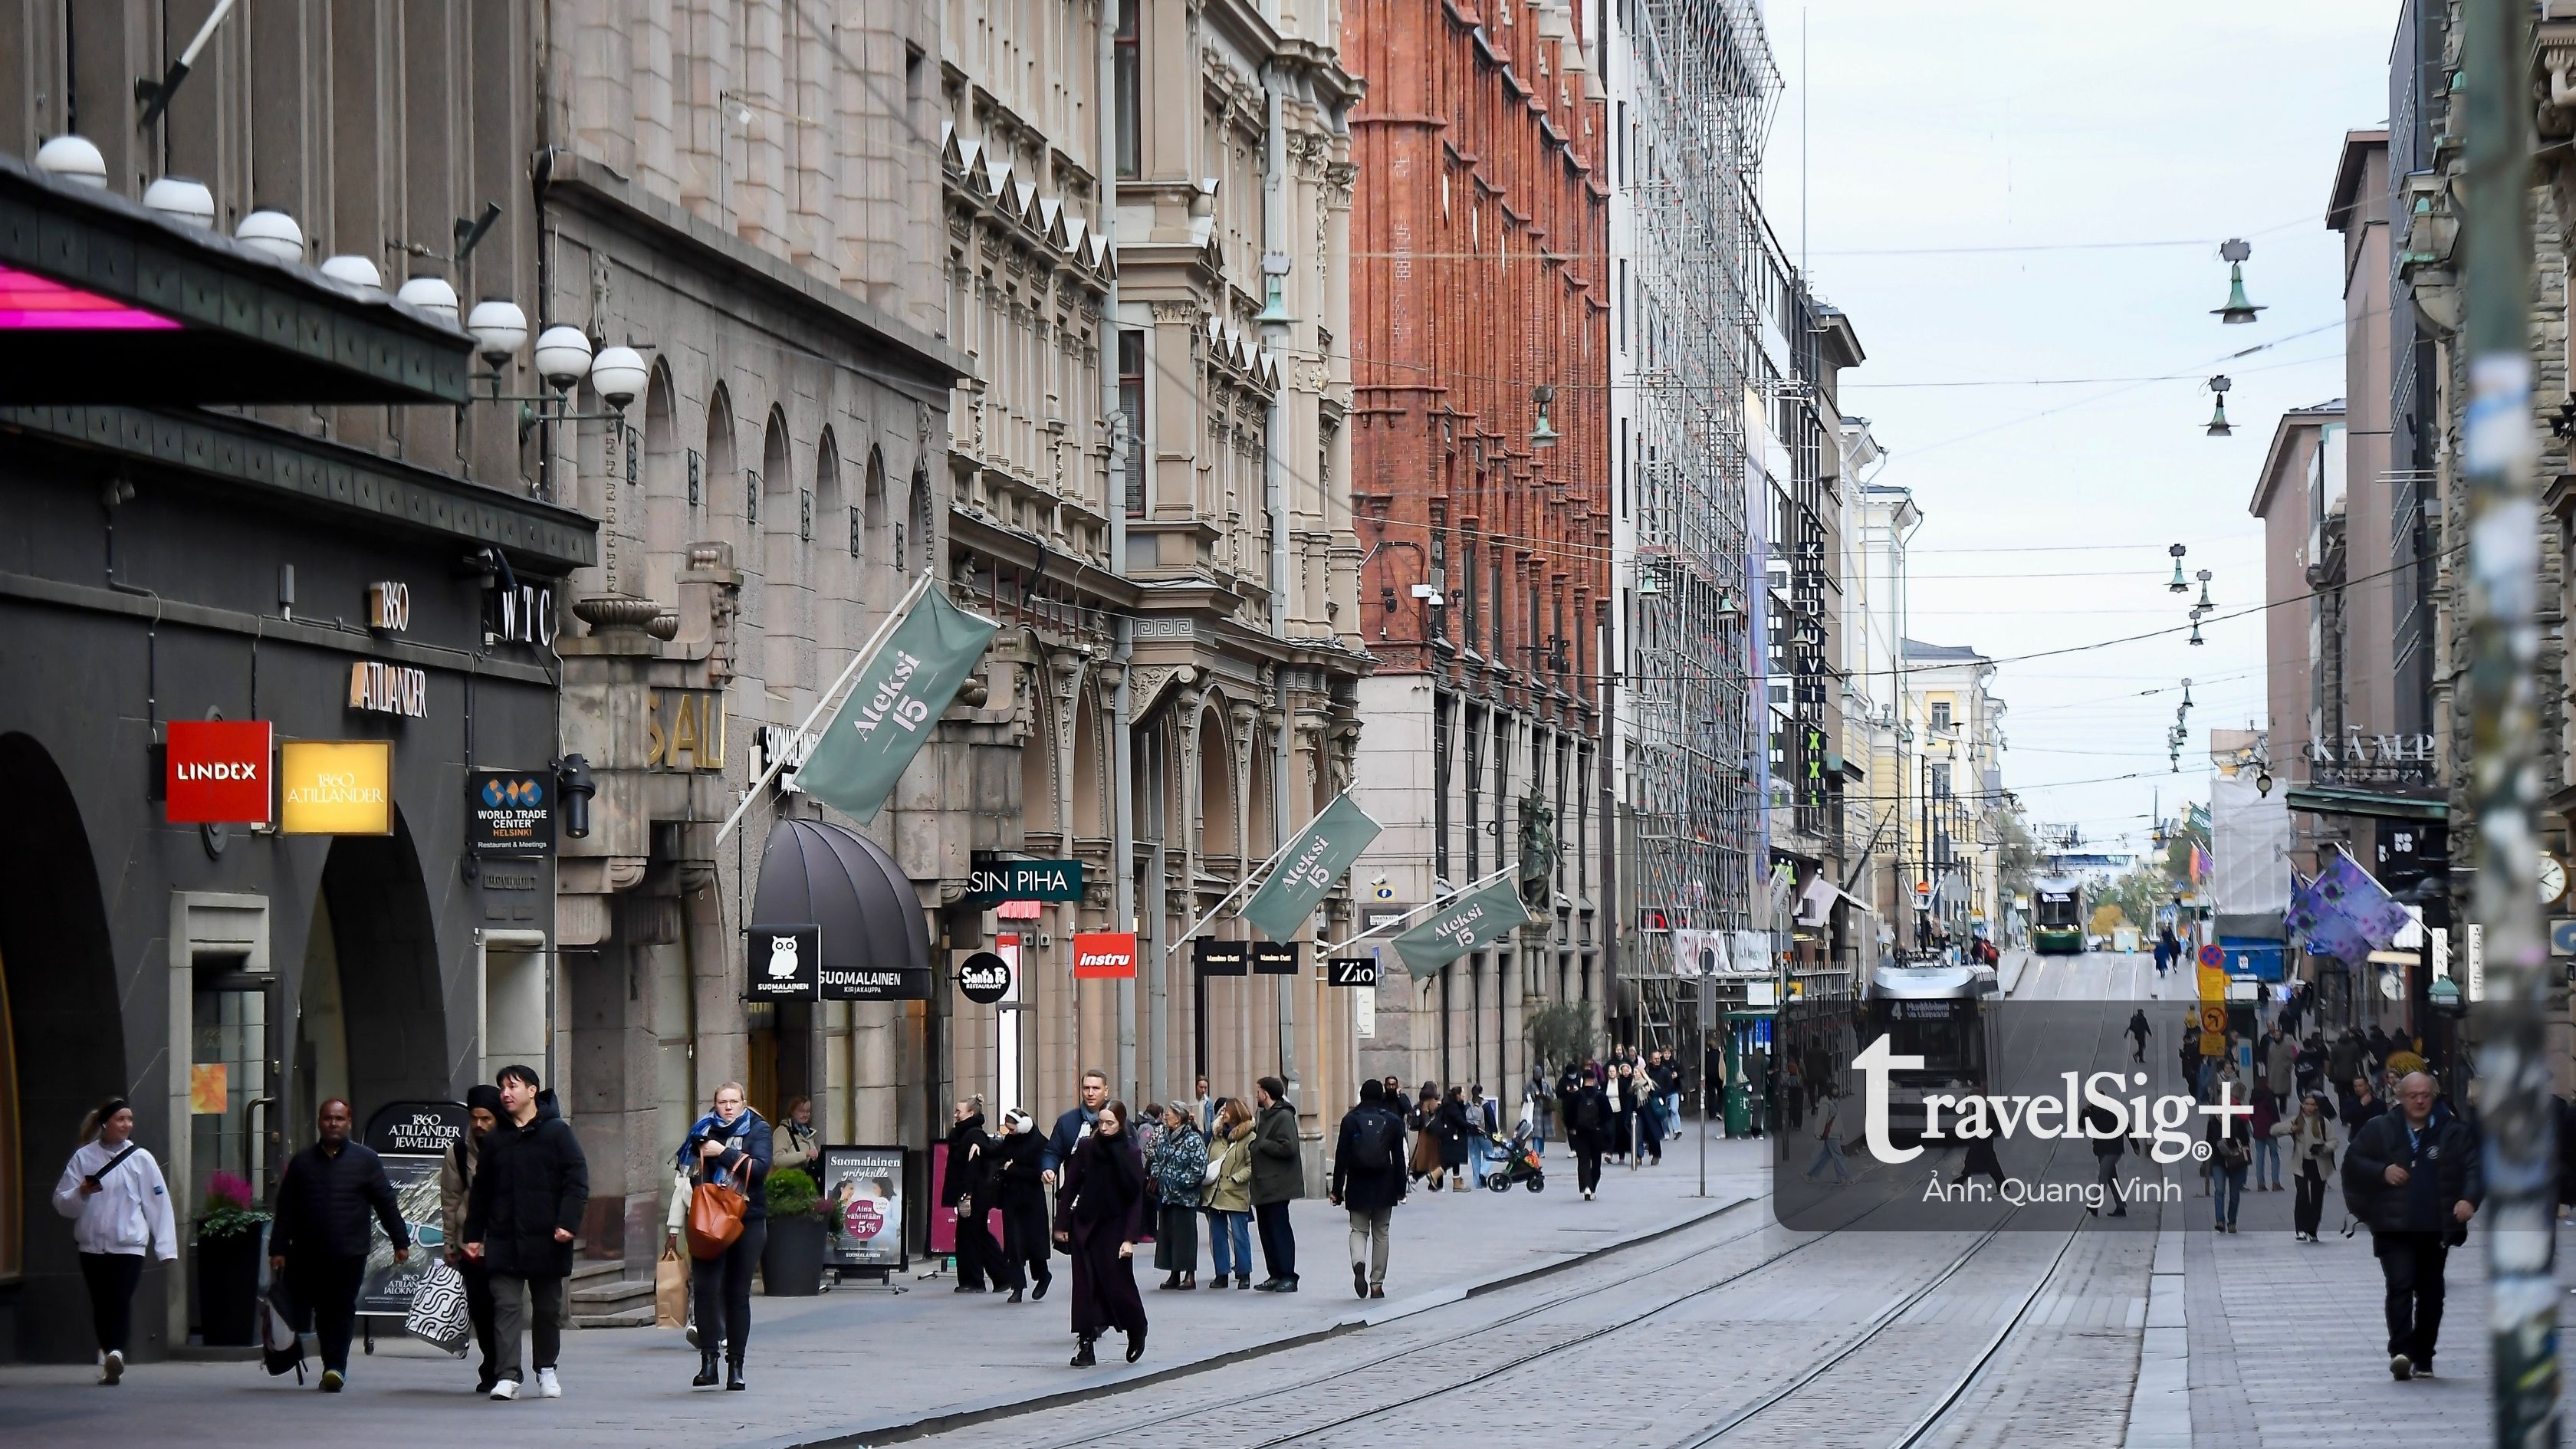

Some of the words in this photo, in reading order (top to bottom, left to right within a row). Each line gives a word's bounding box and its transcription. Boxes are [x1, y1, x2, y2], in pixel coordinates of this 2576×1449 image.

[381, 580, 410, 632] 1860
[502, 585, 550, 646] WTC
[853, 650, 921, 742] Aleksi
[892, 695, 928, 732] 15
[177, 762, 257, 780] LINDEX
[1809, 732, 1820, 807] XXL
[317, 773, 355, 788] 1860
[288, 787, 384, 803] A.TILLANDER
[478, 810, 513, 820] WORLD
[515, 810, 547, 819] TRADE
[1281, 834, 1330, 892] Aleksi
[1017, 870, 1068, 892] PIHA
[1306, 865, 1331, 889] 15
[1434, 902, 1484, 941] Aleksi
[1455, 927, 1475, 948] 15
[1079, 953, 1131, 966] instru
[820, 971, 901, 986] SUOMALAINEN
[961, 967, 994, 984] Santa
[1339, 961, 1374, 983] Zio
[1891, 1001, 1902, 1020] 4
[412, 1114, 442, 1125] 1860
[388, 1125, 461, 1138] A.TILLANDER
[394, 1136, 455, 1148] JEWELLERS
[830, 1156, 901, 1167] Suomalainen
[842, 1167, 889, 1181] yrityksille
